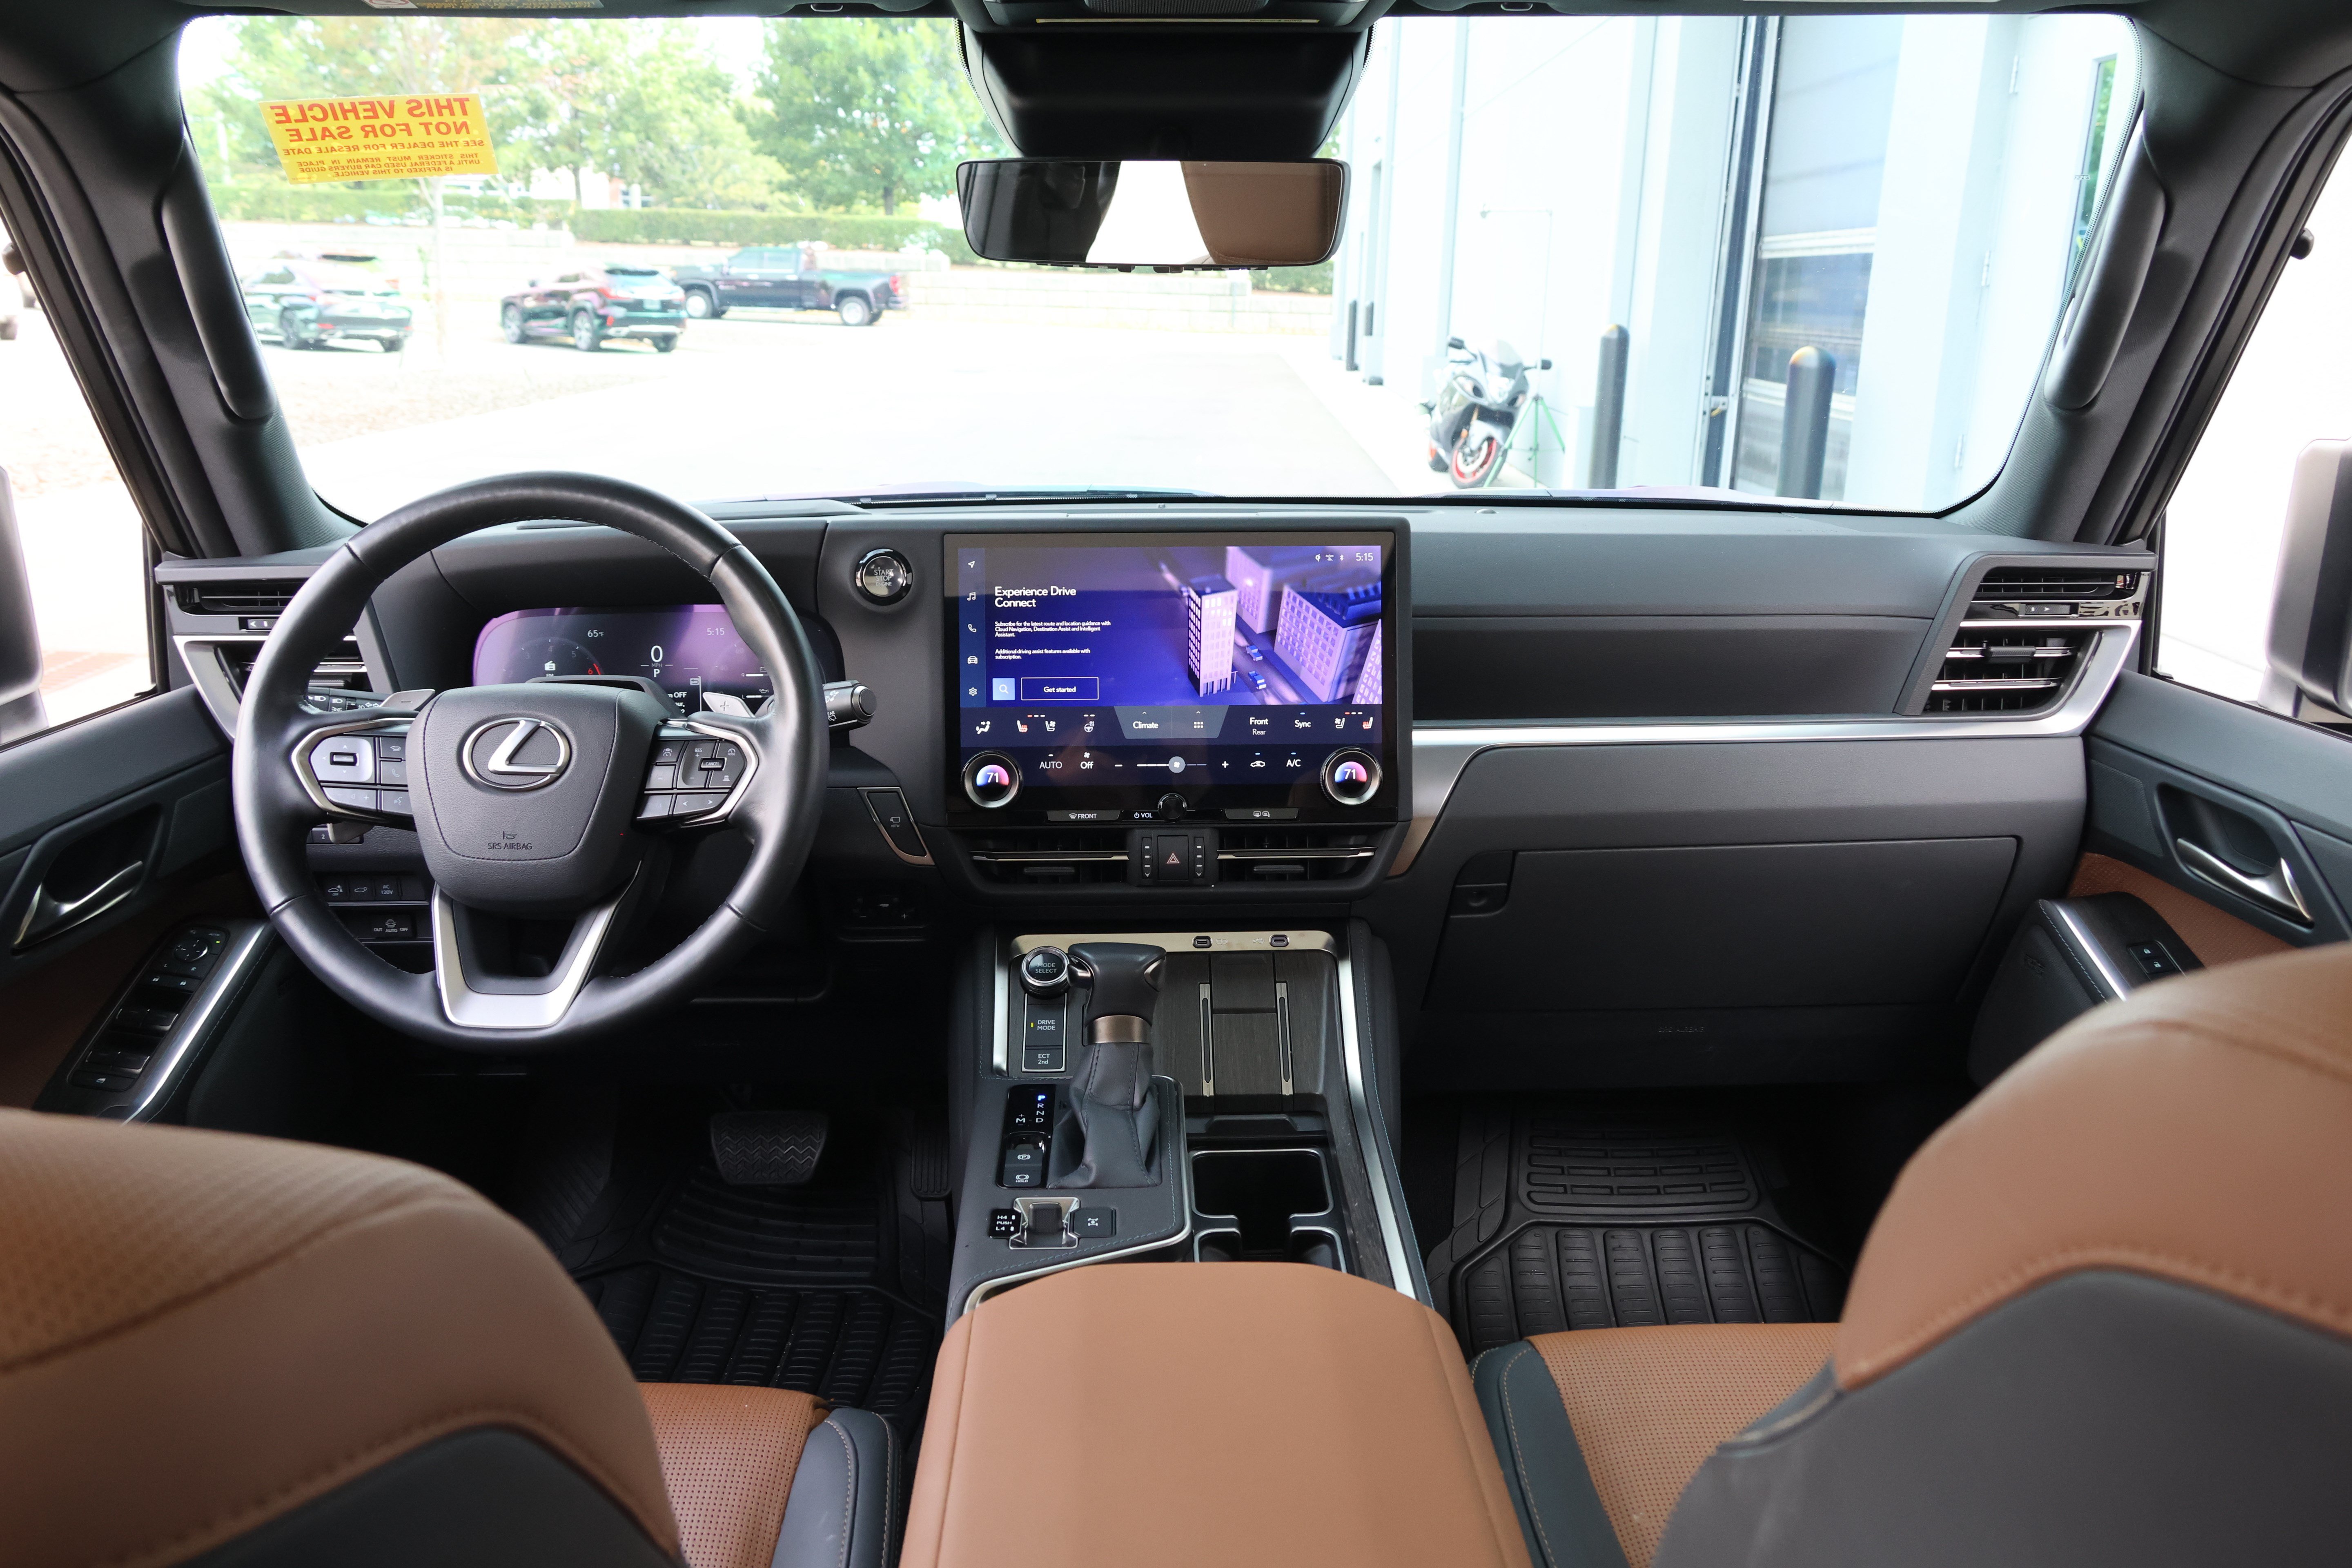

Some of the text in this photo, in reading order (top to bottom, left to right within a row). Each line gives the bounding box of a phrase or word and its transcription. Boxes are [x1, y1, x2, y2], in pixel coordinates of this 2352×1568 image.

[1356, 552, 1374, 562] 5:15
[995, 586, 1076, 598] Experience Drive
[995, 597, 1036, 607] Connect
[650, 646, 663, 662] 0
[654, 669, 660, 677] P
[1295, 720, 1311, 729] Sync
[1039, 761, 1062, 769] AUTO
[1080, 761, 1094, 769] Off
[987, 772, 999, 783] 71
[1344, 769, 1356, 779] 71
